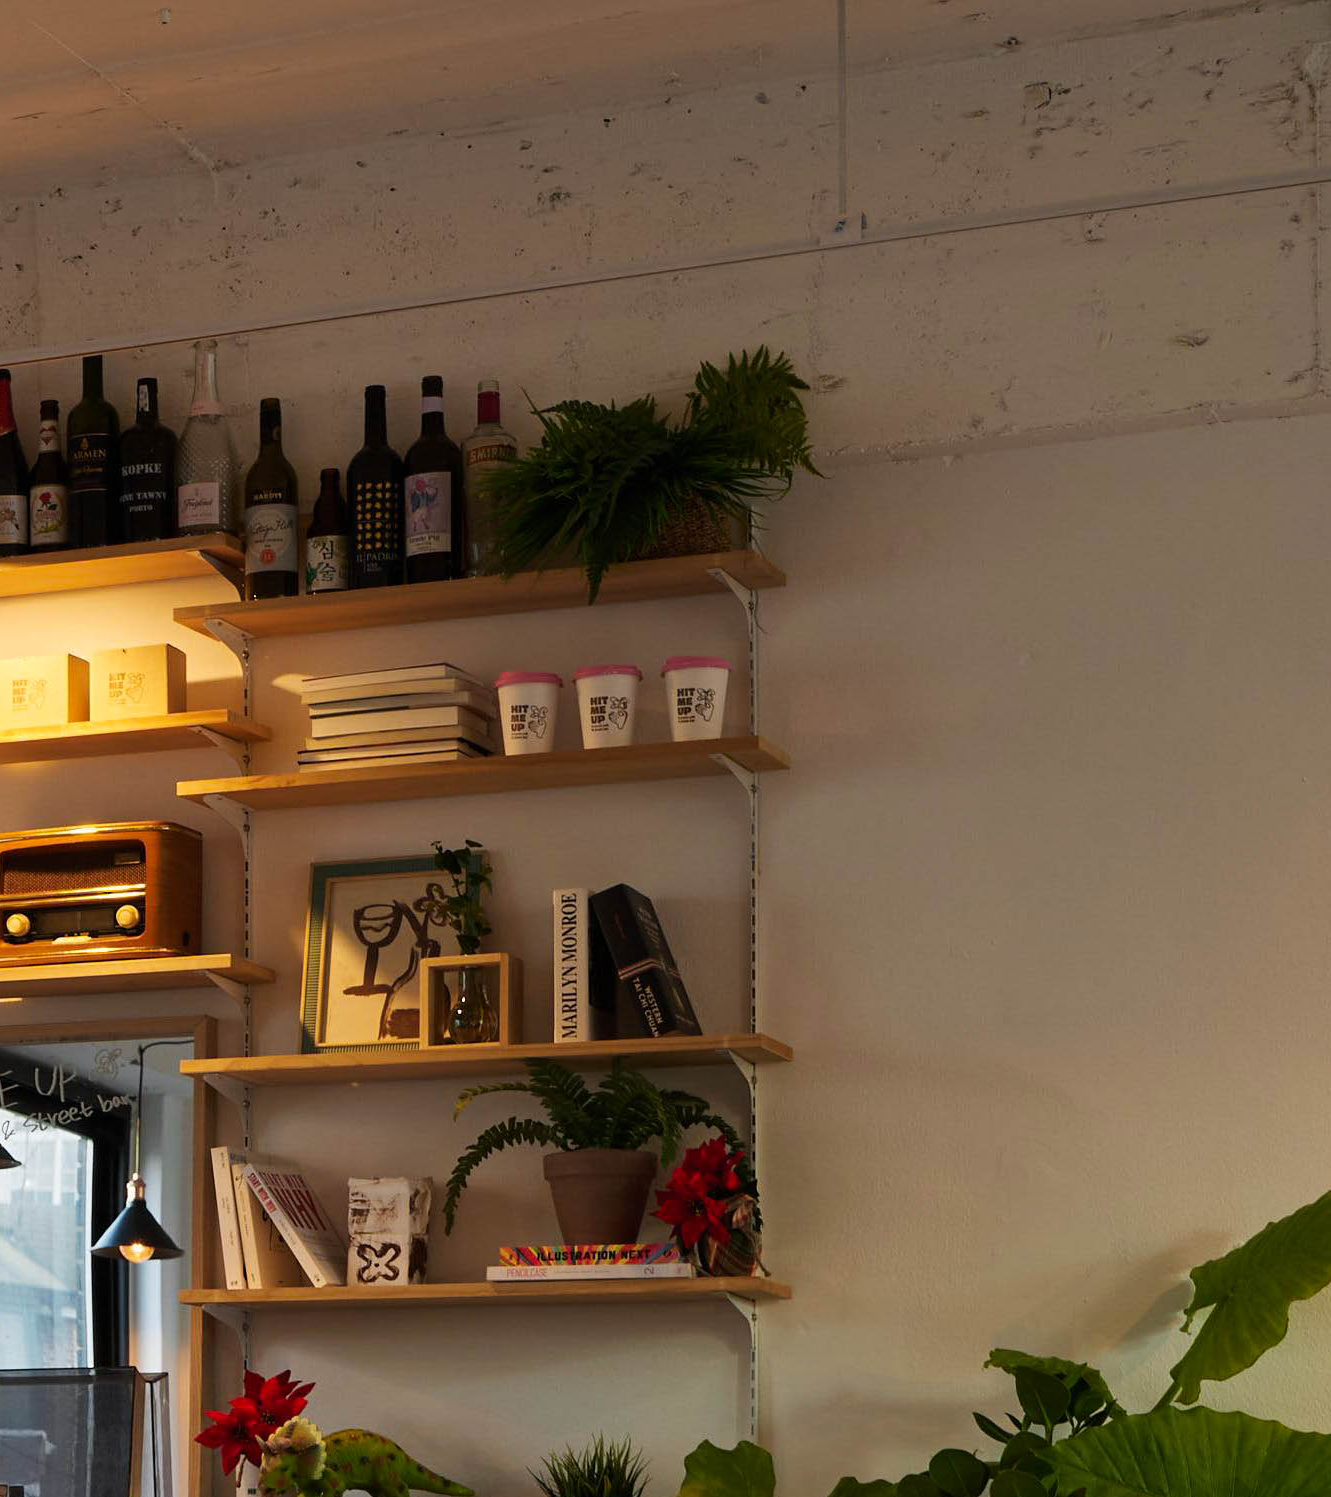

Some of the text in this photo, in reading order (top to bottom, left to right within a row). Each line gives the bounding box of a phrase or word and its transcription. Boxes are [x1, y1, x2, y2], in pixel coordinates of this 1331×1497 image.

[69, 447, 107, 460] ARMEN
[121, 463, 163, 478] KOPKE
[677, 688, 695, 697] HIT
[590, 696, 608, 705] HIT
[677, 697, 693, 706] ME
[510, 705, 529, 714] HIT
[590, 706, 606, 714] ME
[677, 707, 692, 715] UP
[510, 714, 526, 722] ME
[591, 715, 606, 724] UP
[511, 723, 525, 732] UP
[561, 893, 578, 1039] MARILYN MONROE
[643, 983, 665, 1025] WESTERN
[33, 1064, 77, 1103] UP
[536, 1248, 652, 1262] ILLUSTRATION NEXT
